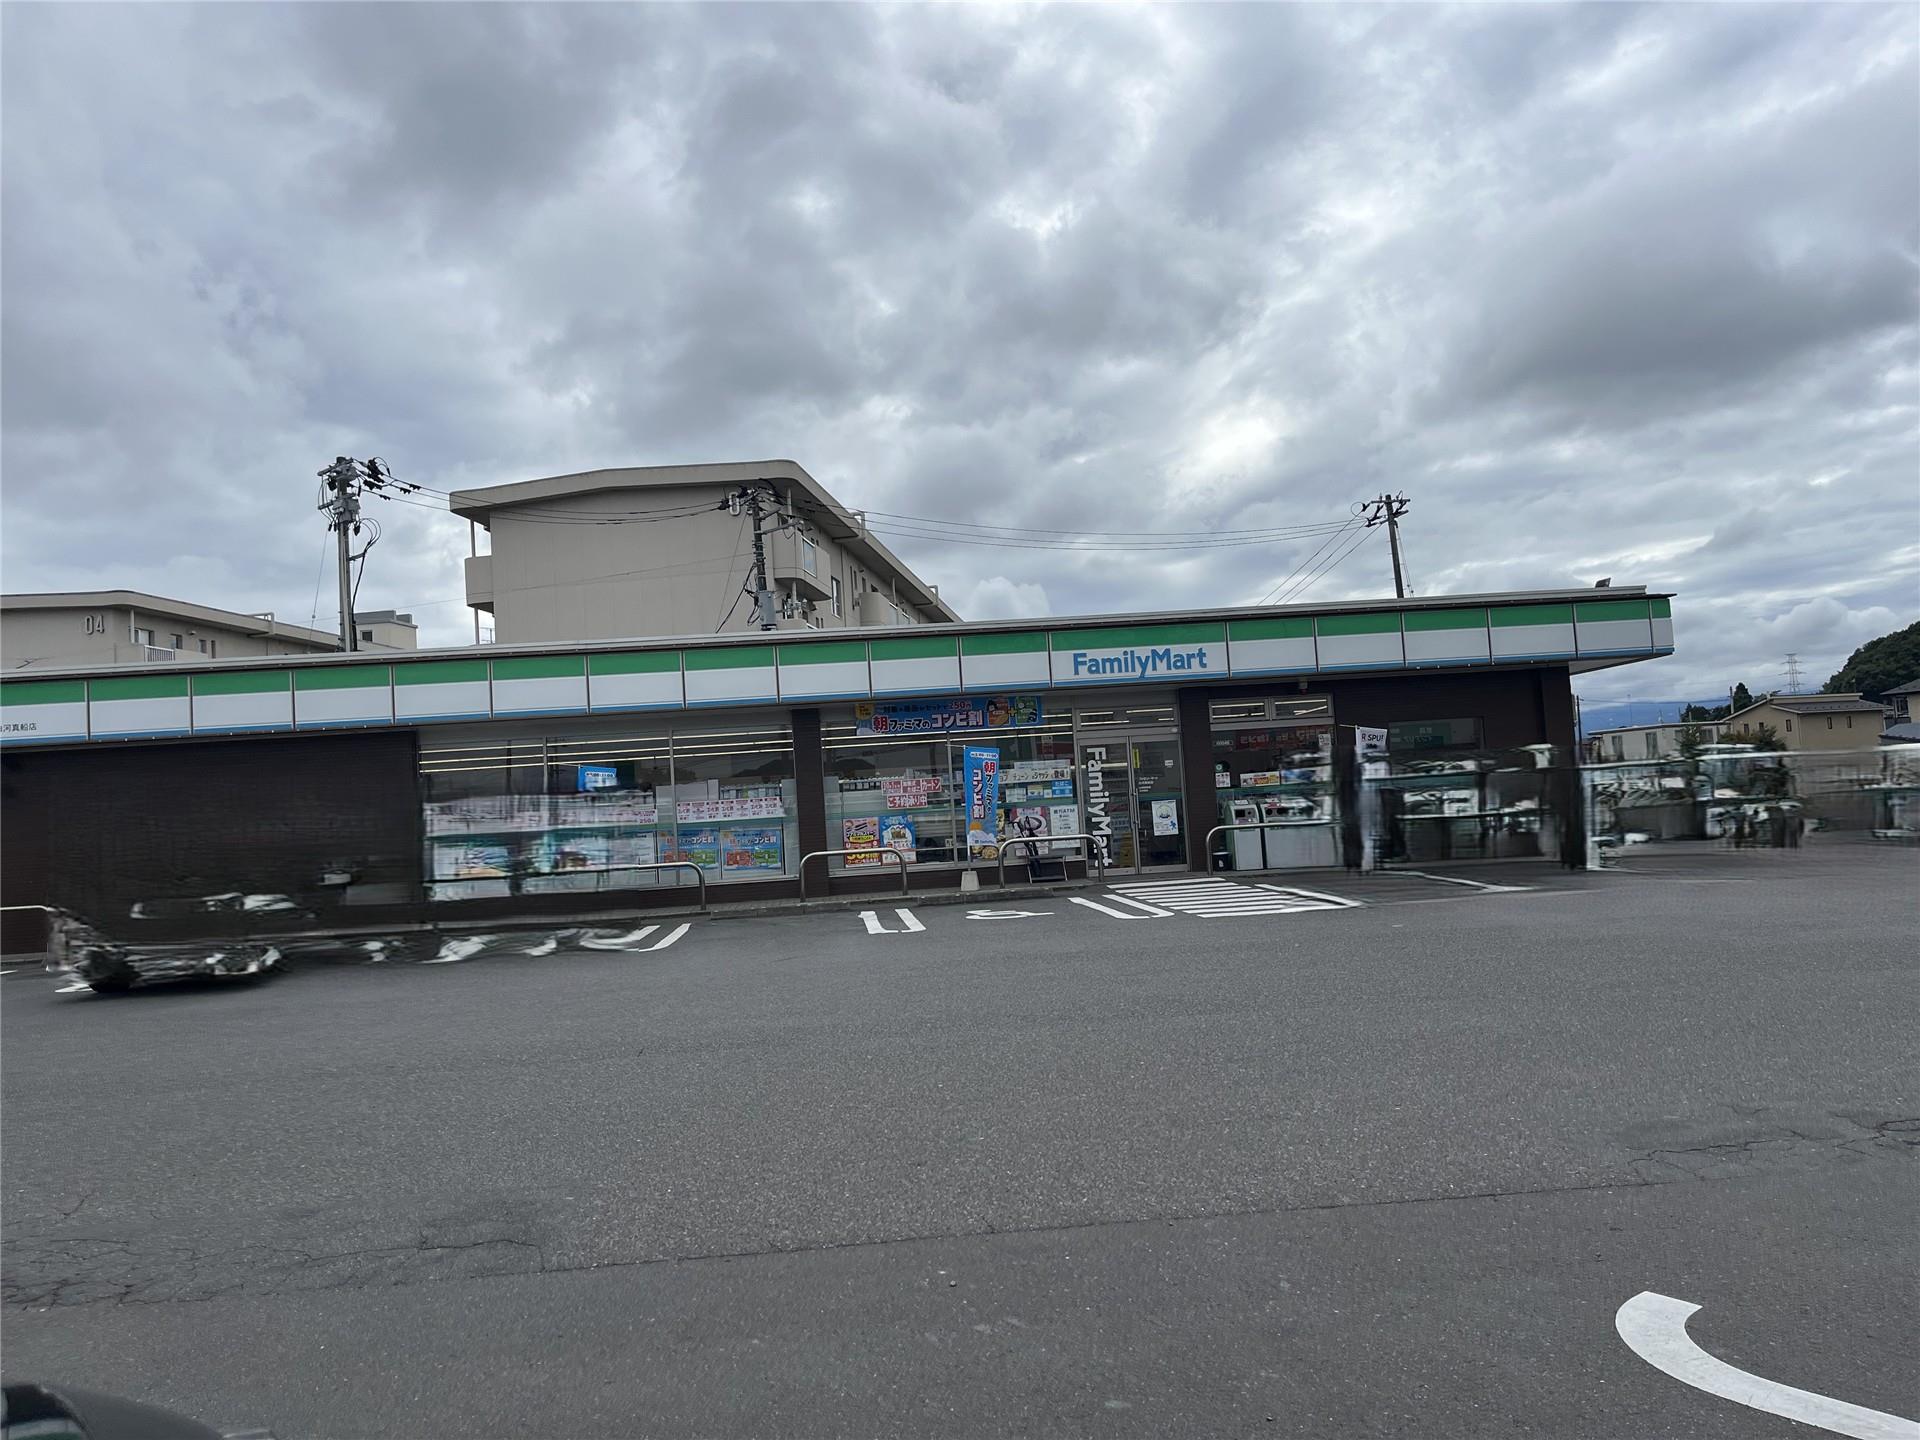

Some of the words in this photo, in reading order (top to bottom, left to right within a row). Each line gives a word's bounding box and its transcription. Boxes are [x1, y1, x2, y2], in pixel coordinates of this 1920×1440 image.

[85, 615, 105, 635] 04
[1073, 648, 1207, 680] FamilyMart
[1087, 747, 1113, 867] FamilyMart
